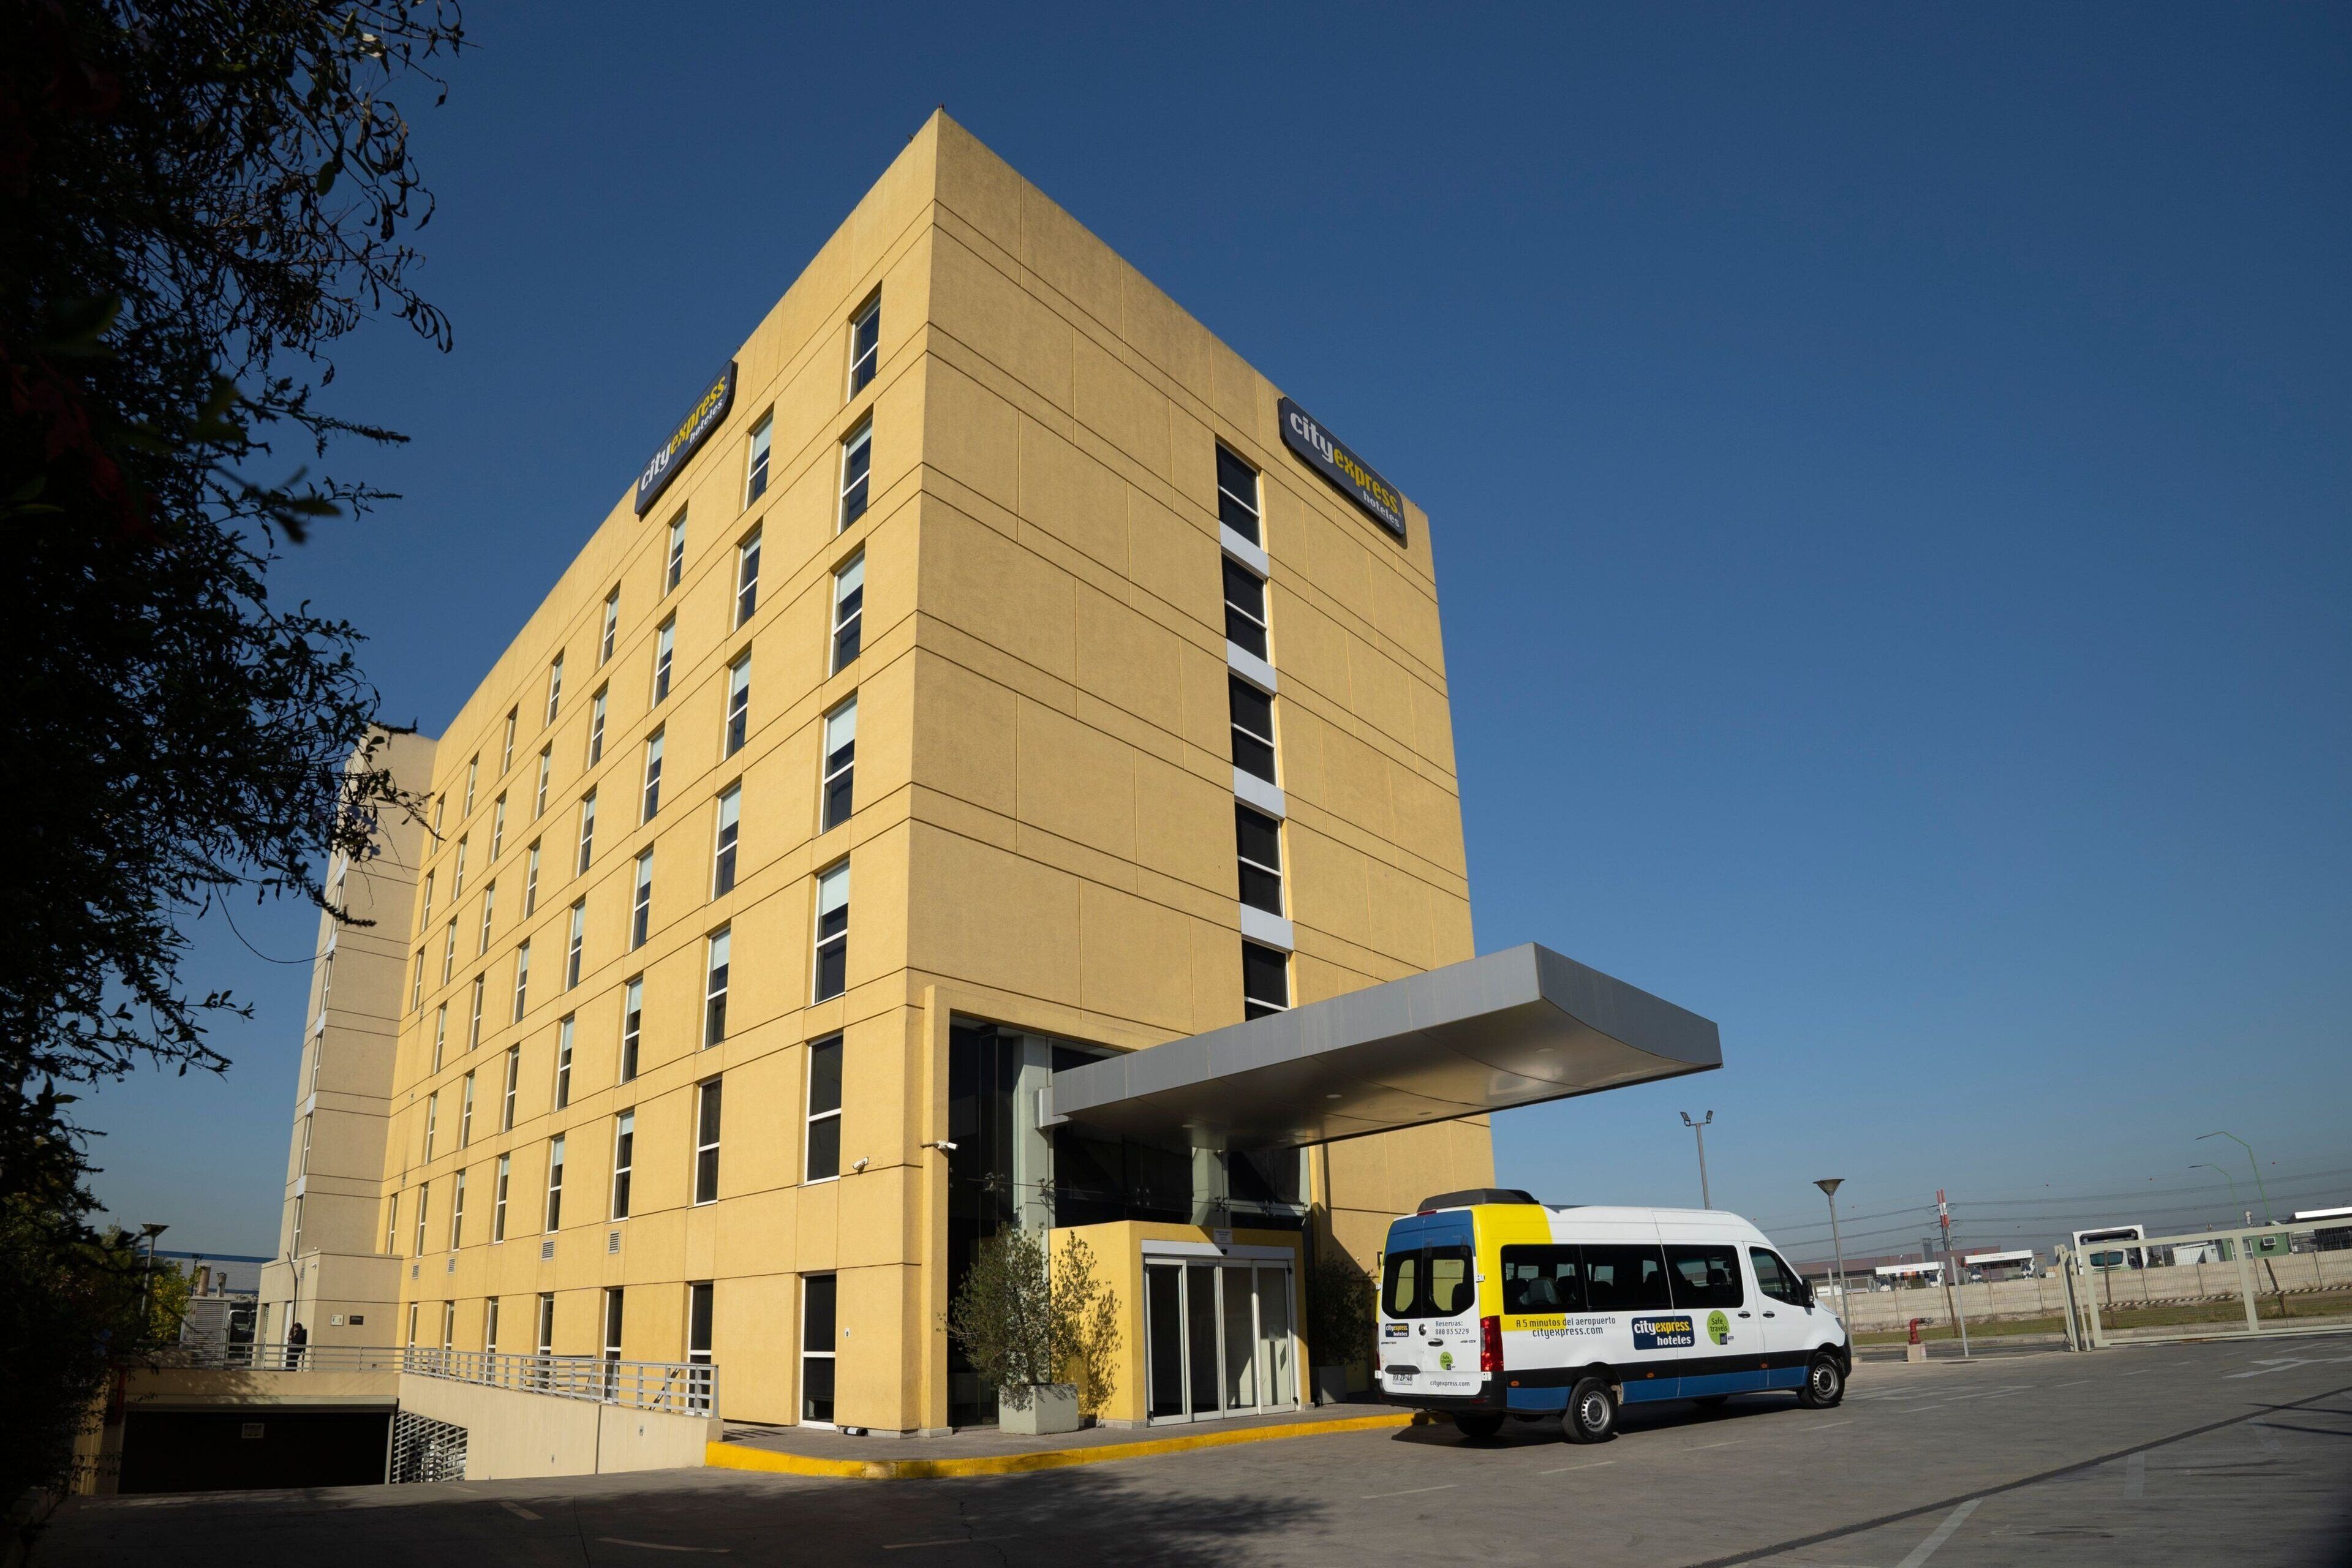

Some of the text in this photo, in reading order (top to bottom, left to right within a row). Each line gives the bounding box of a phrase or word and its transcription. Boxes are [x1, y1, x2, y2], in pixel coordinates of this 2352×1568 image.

[690, 399, 723, 443] hoteles
[1363, 490, 1400, 528] hoteles
[1529, 1318, 1561, 1327] minutos
[1562, 1317, 1574, 1326] del
[1575, 1316, 1616, 1326] aeropuerto
[1634, 1320, 1691, 1335] cityexpress
[1532, 1327, 1604, 1339] cityexpress.com
[1710, 1324, 1728, 1332] travels
[1657, 1336, 1691, 1346] hoteles
